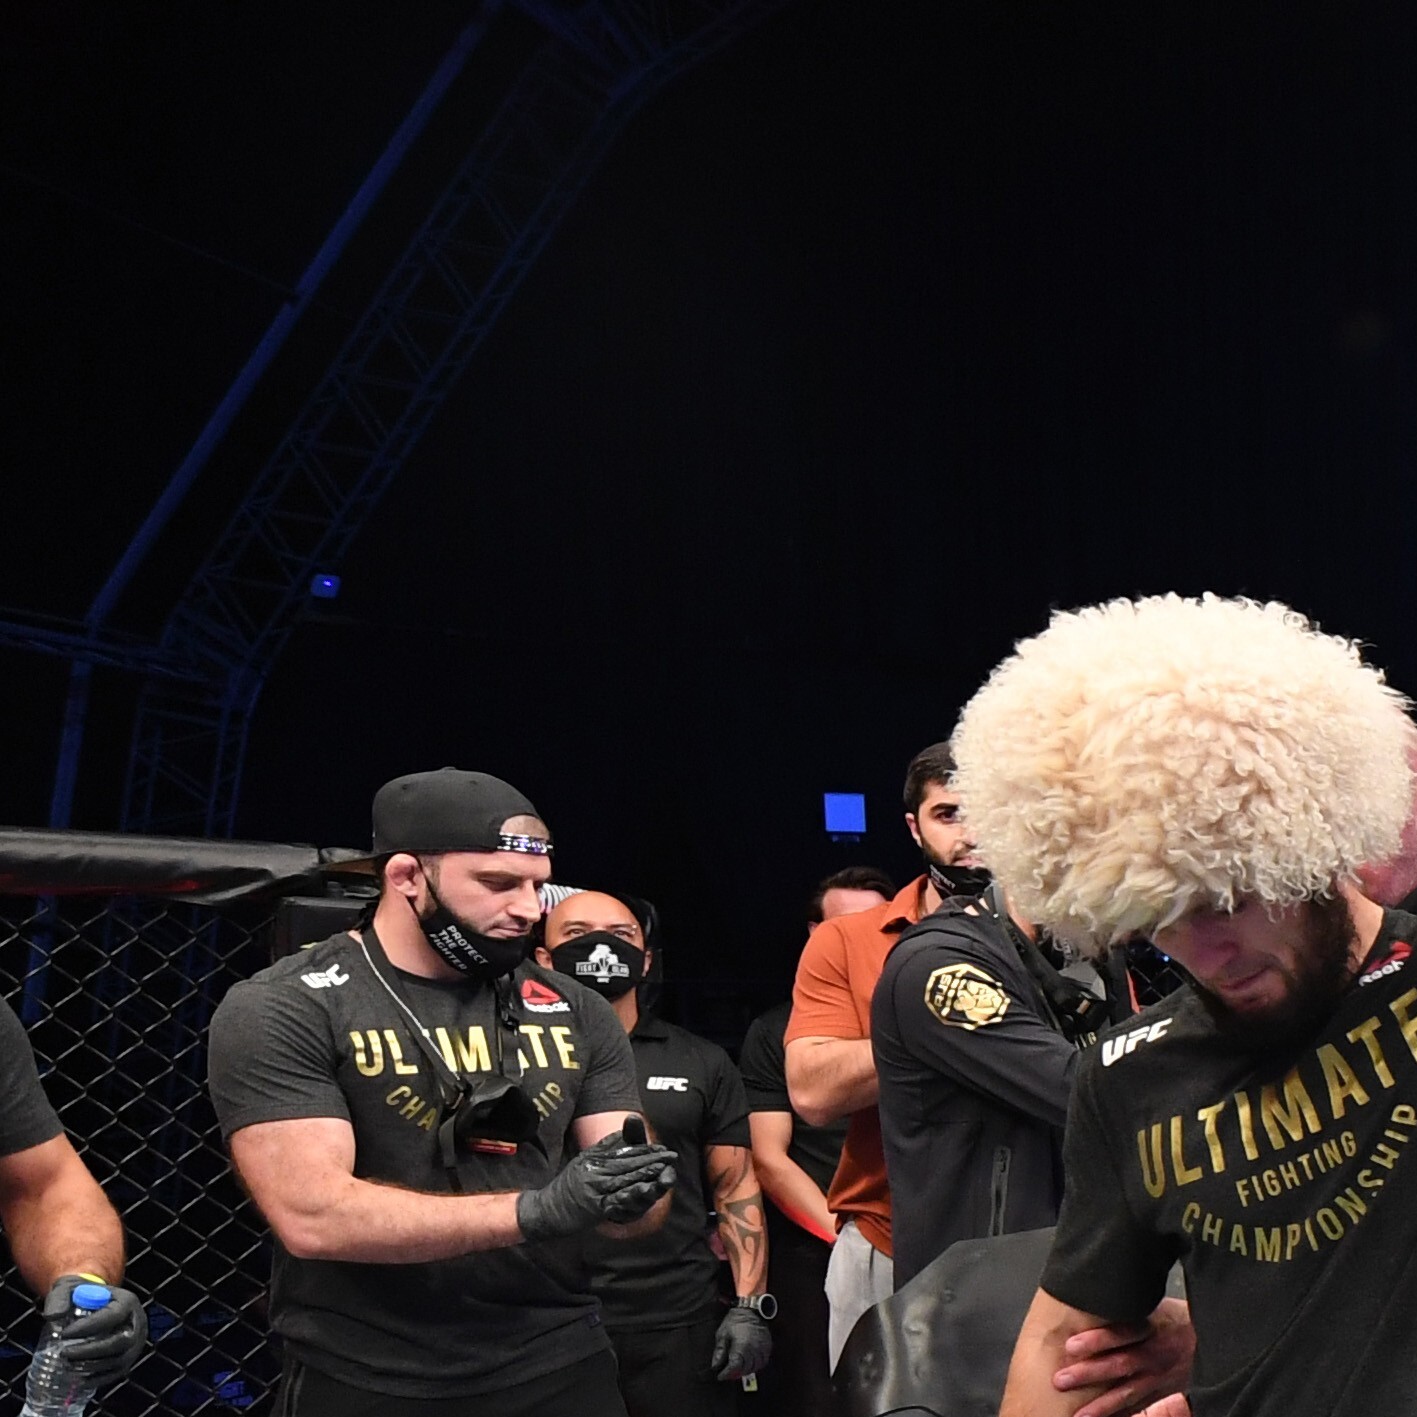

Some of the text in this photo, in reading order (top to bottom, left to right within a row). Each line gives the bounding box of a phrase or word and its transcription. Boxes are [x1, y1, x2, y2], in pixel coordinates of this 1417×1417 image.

[438, 929, 458, 950] THE
[446, 924, 489, 965] PROTECT
[300, 963, 350, 989] UFC
[349, 1024, 581, 1077] ULIMTE
[1101, 1017, 1174, 1067] UFC
[646, 1076, 689, 1092] UFC
[1234, 1130, 1358, 1208] FIGHTING
